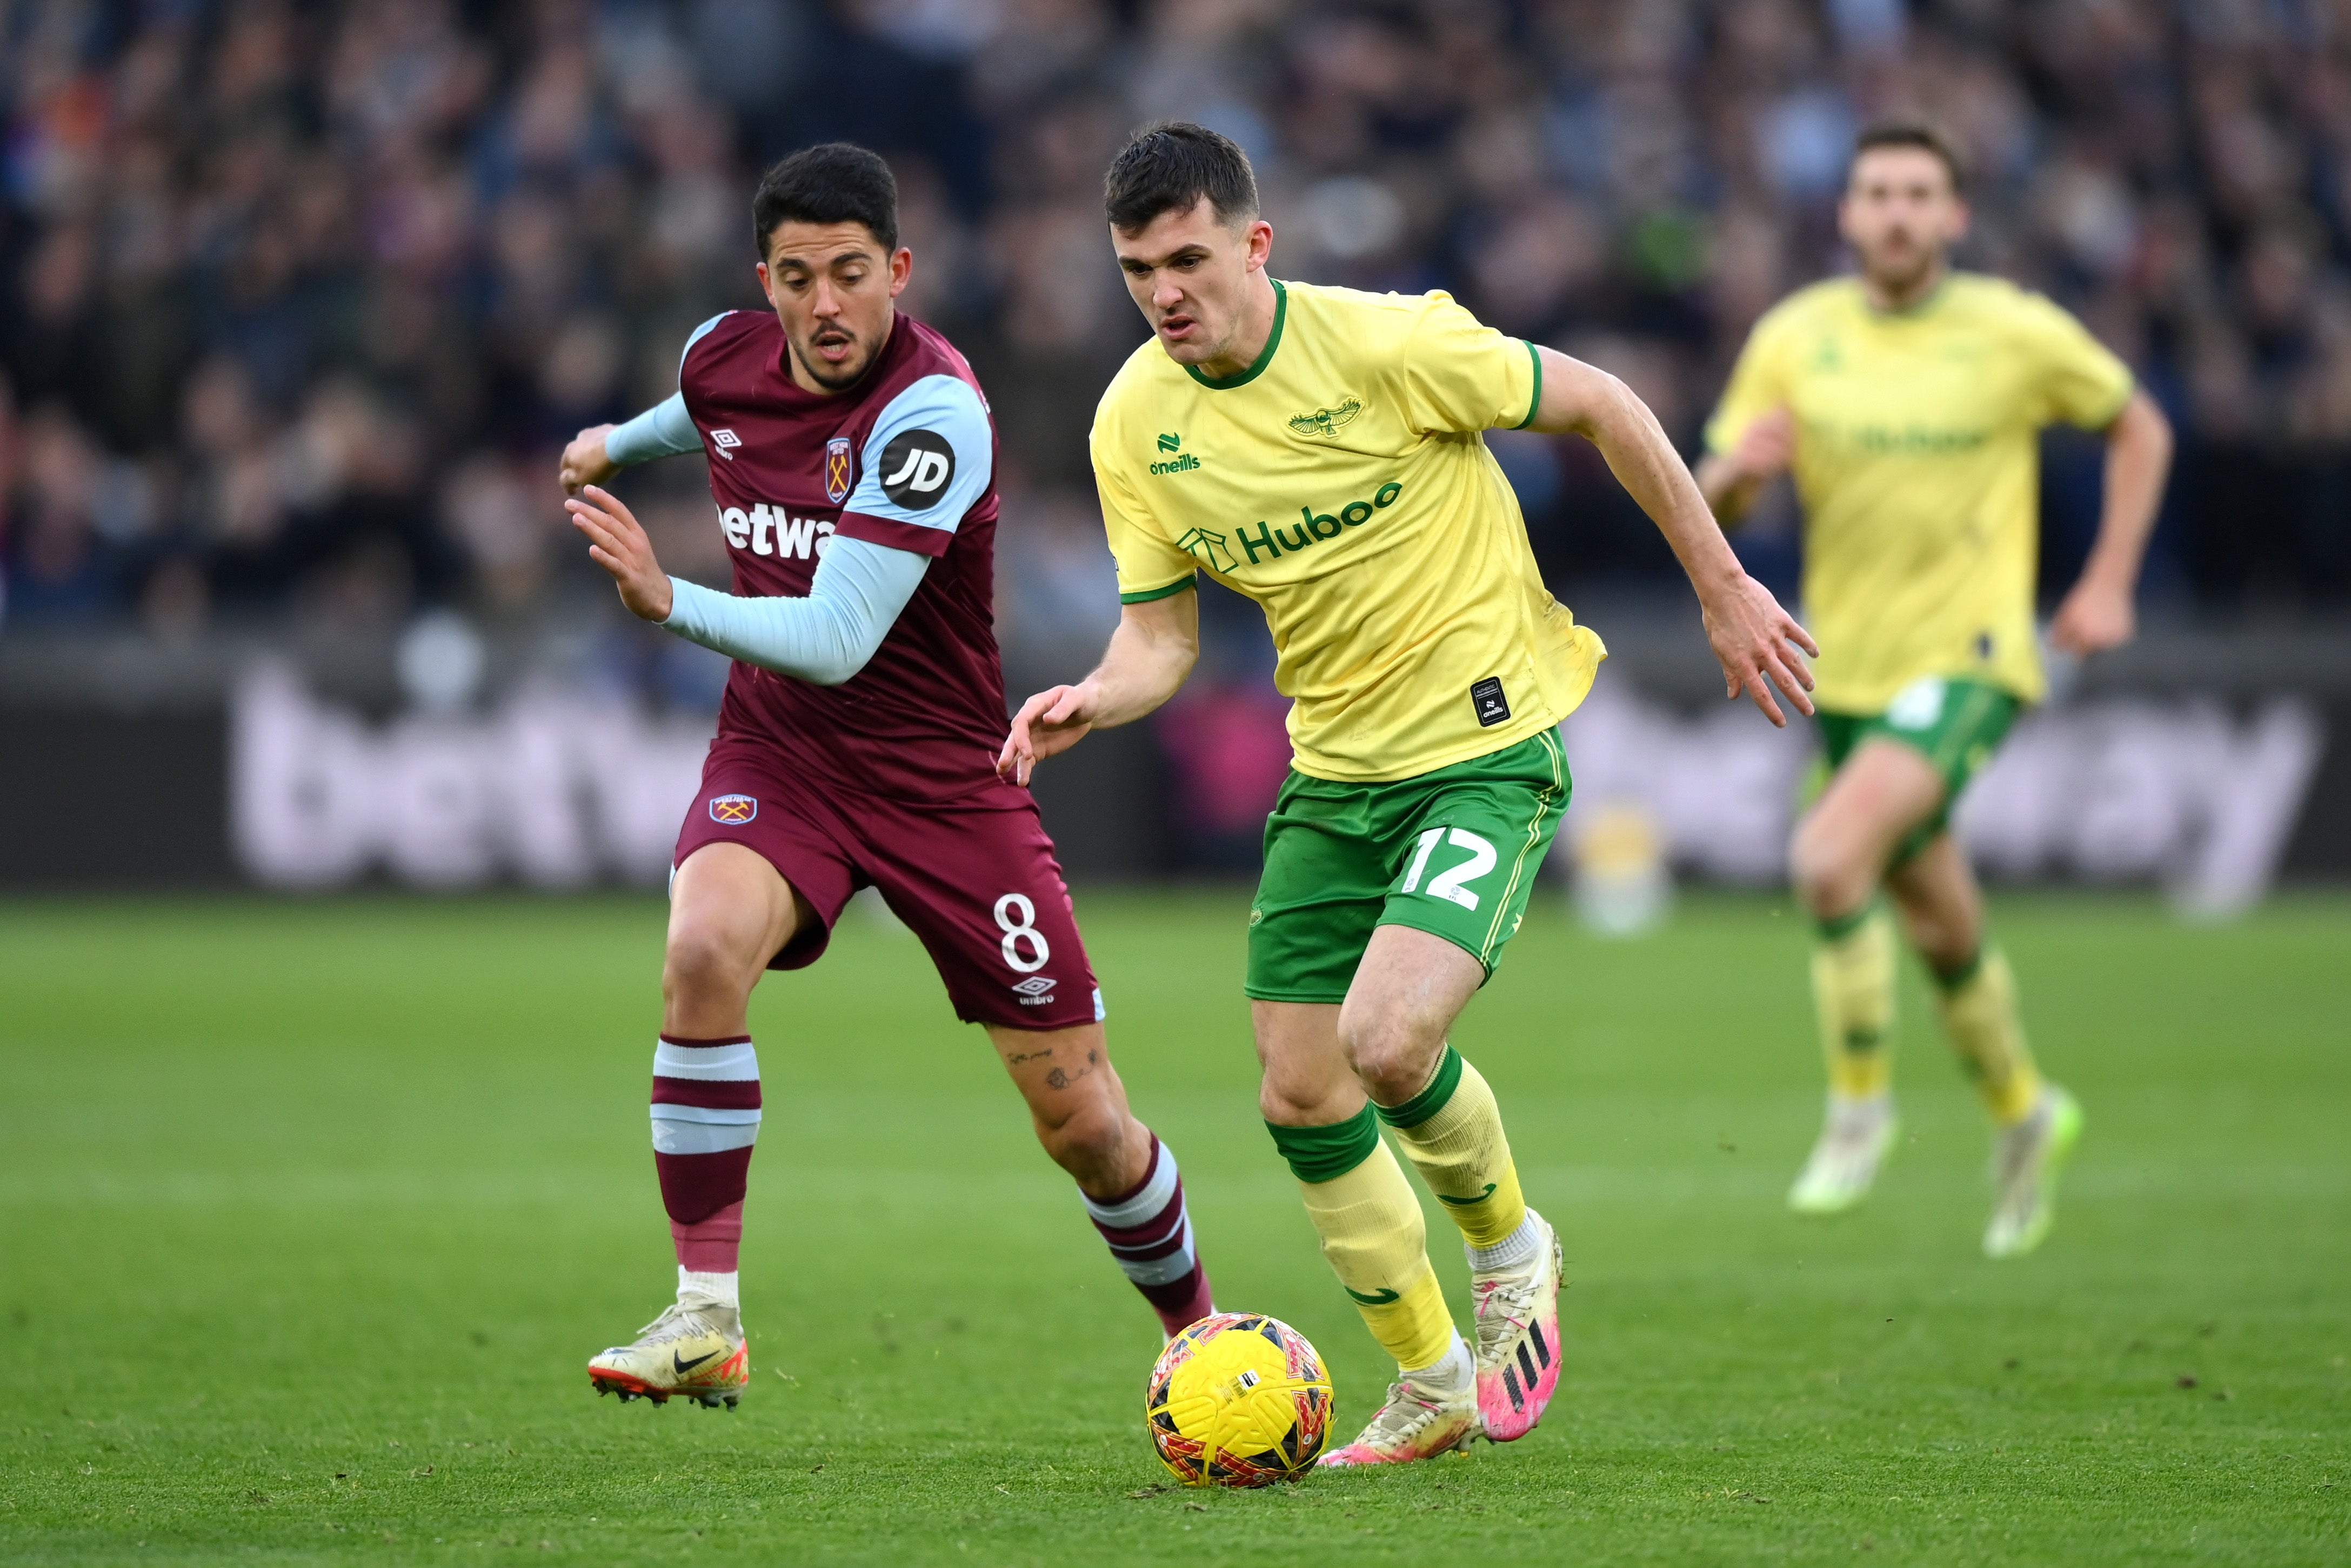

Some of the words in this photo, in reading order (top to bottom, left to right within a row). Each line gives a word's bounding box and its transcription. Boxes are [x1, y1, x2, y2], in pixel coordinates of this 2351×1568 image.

[885, 448, 949, 492] JD
[1235, 482, 1402, 565] Huboo
[1401, 826, 1497, 912] 12
[993, 893, 1050, 973] 8
[1019, 995, 1054, 1006] umbro
